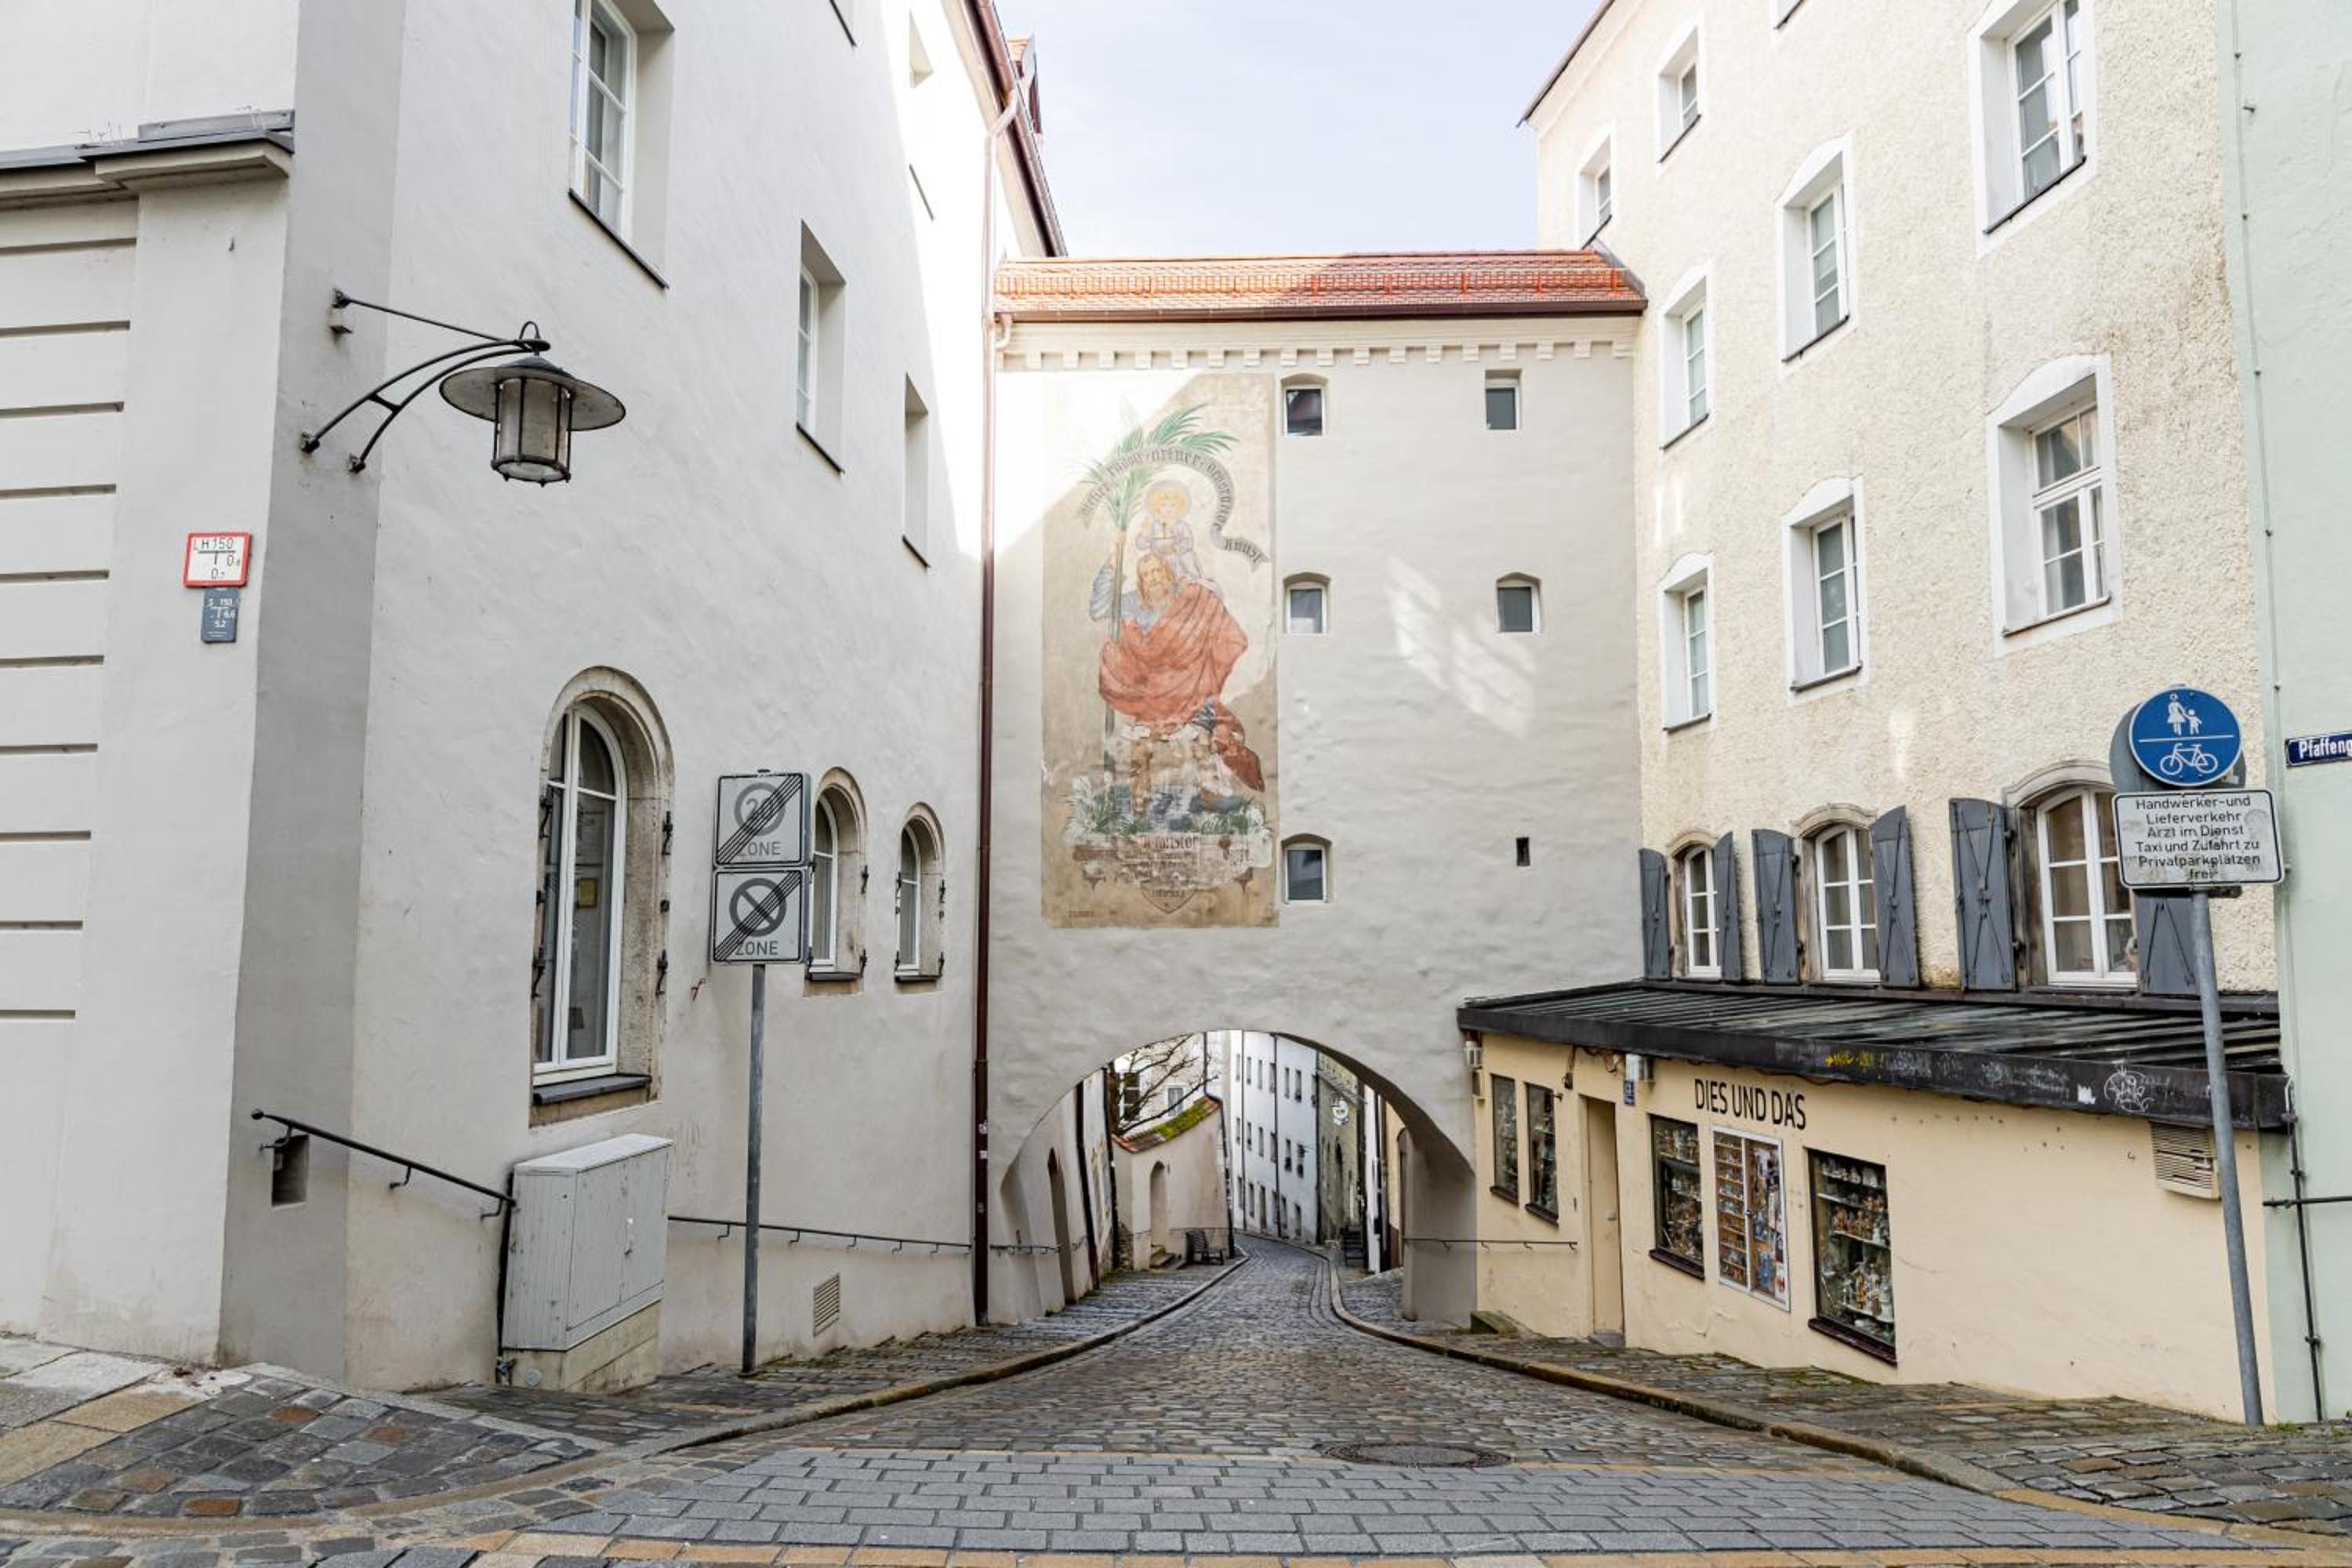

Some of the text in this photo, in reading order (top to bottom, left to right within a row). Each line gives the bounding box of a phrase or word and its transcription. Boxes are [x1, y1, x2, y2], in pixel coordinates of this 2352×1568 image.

[2146, 811, 2241, 825] Lieferverkehr
[2147, 824, 2244, 838] Arzt im Dienst
[2136, 840, 2259, 853] Taxi und Zufahrt zu
[1694, 1078, 1806, 1131] DIES UND DAS
